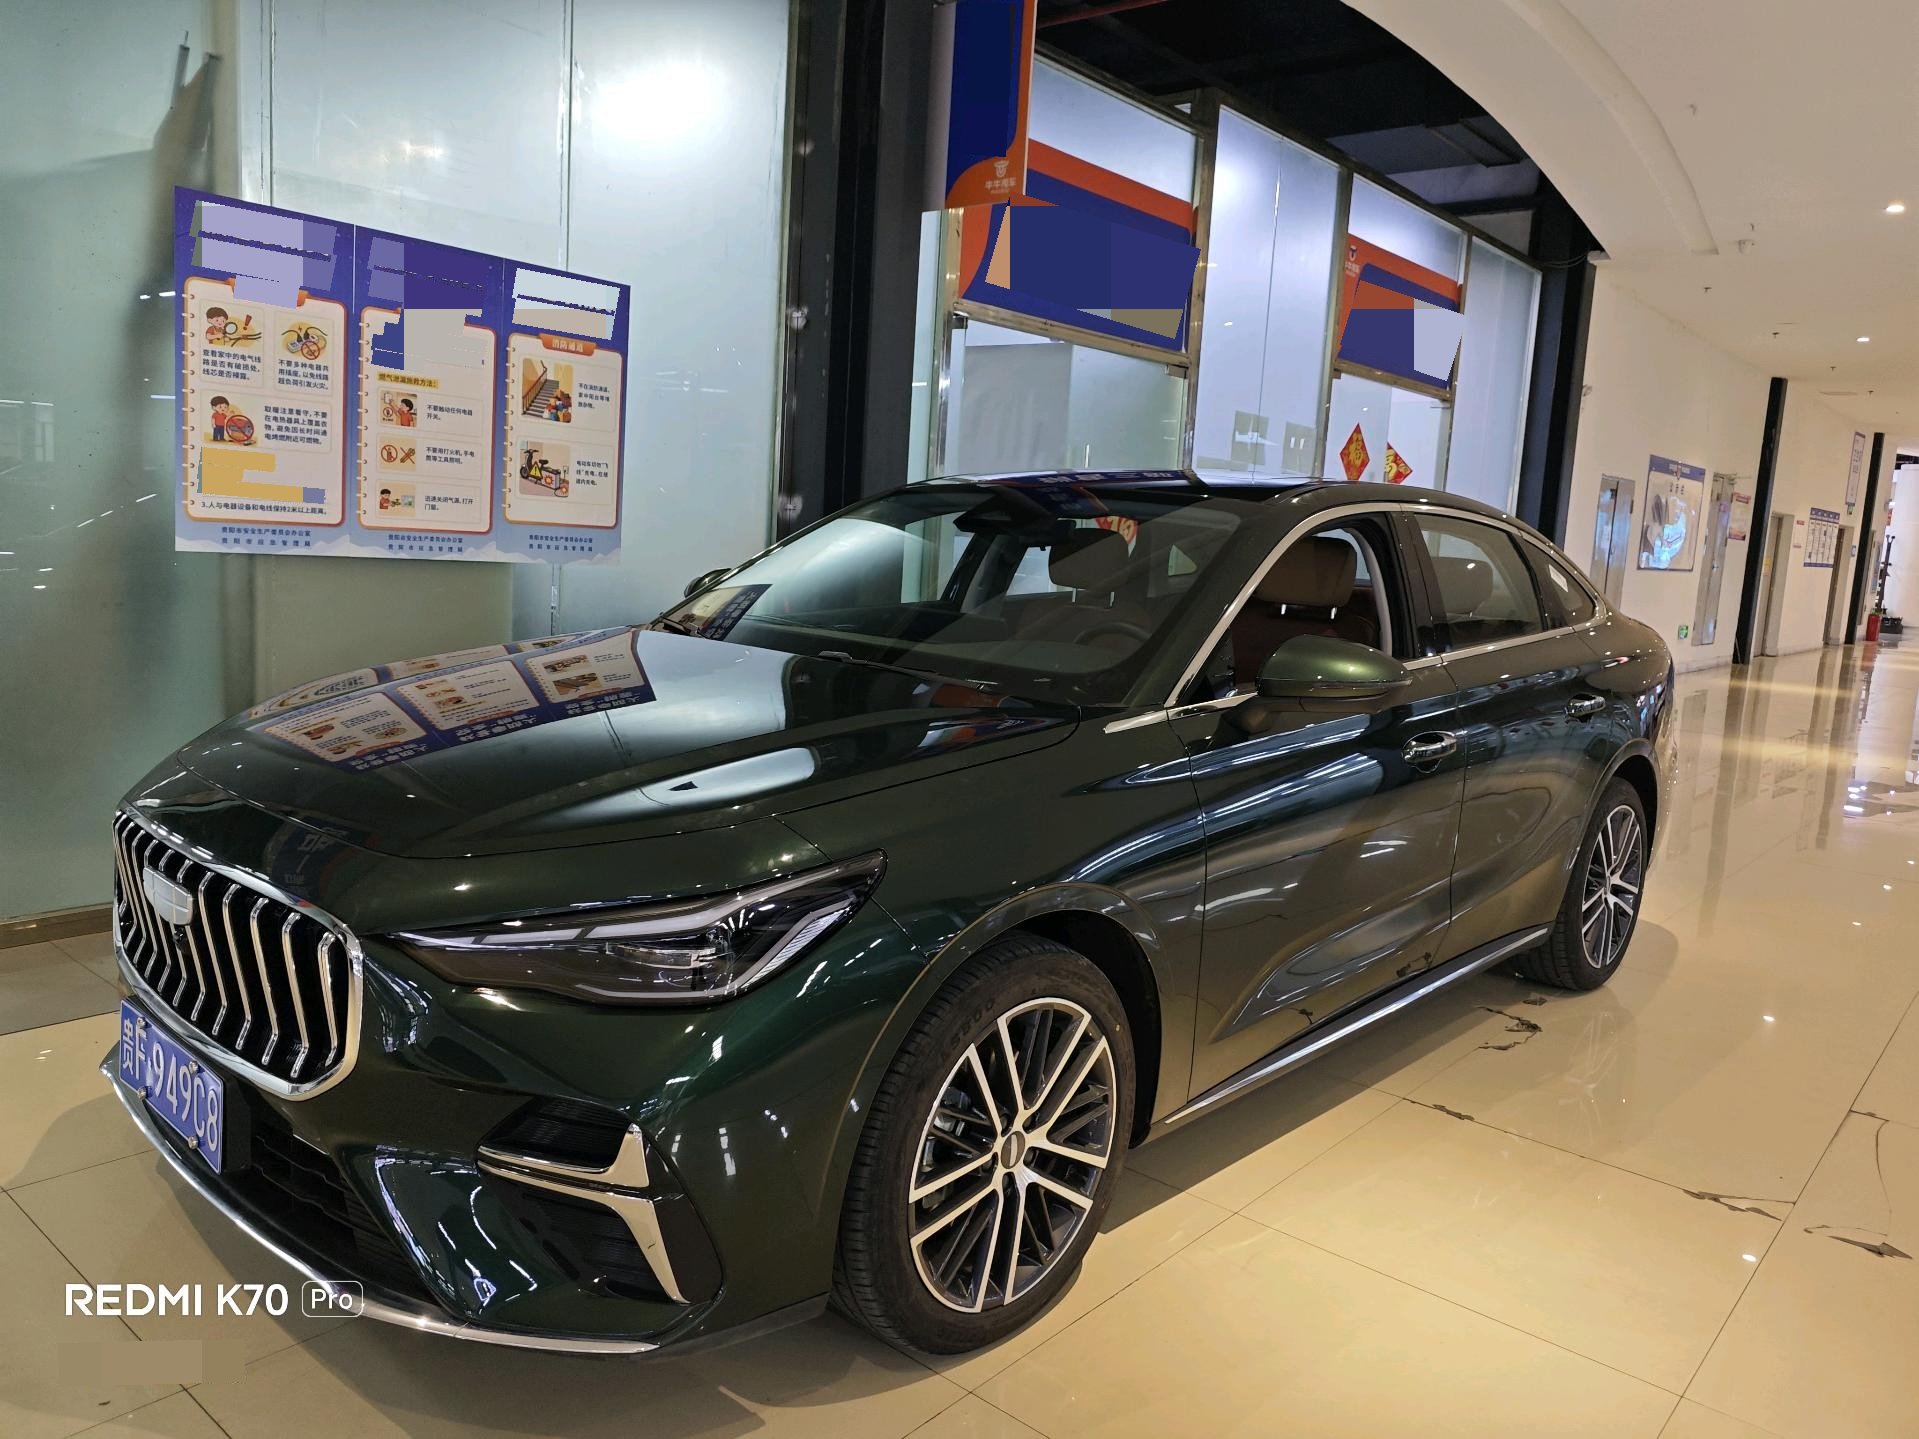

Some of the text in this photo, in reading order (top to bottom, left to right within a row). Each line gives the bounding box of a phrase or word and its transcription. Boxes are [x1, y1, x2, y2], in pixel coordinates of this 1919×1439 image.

[202, 349, 262, 363] 查看家中的电气线
[278, 359, 329, 372] 不要多种电器共
[426, 404, 473, 416] 不要触动任何电器
